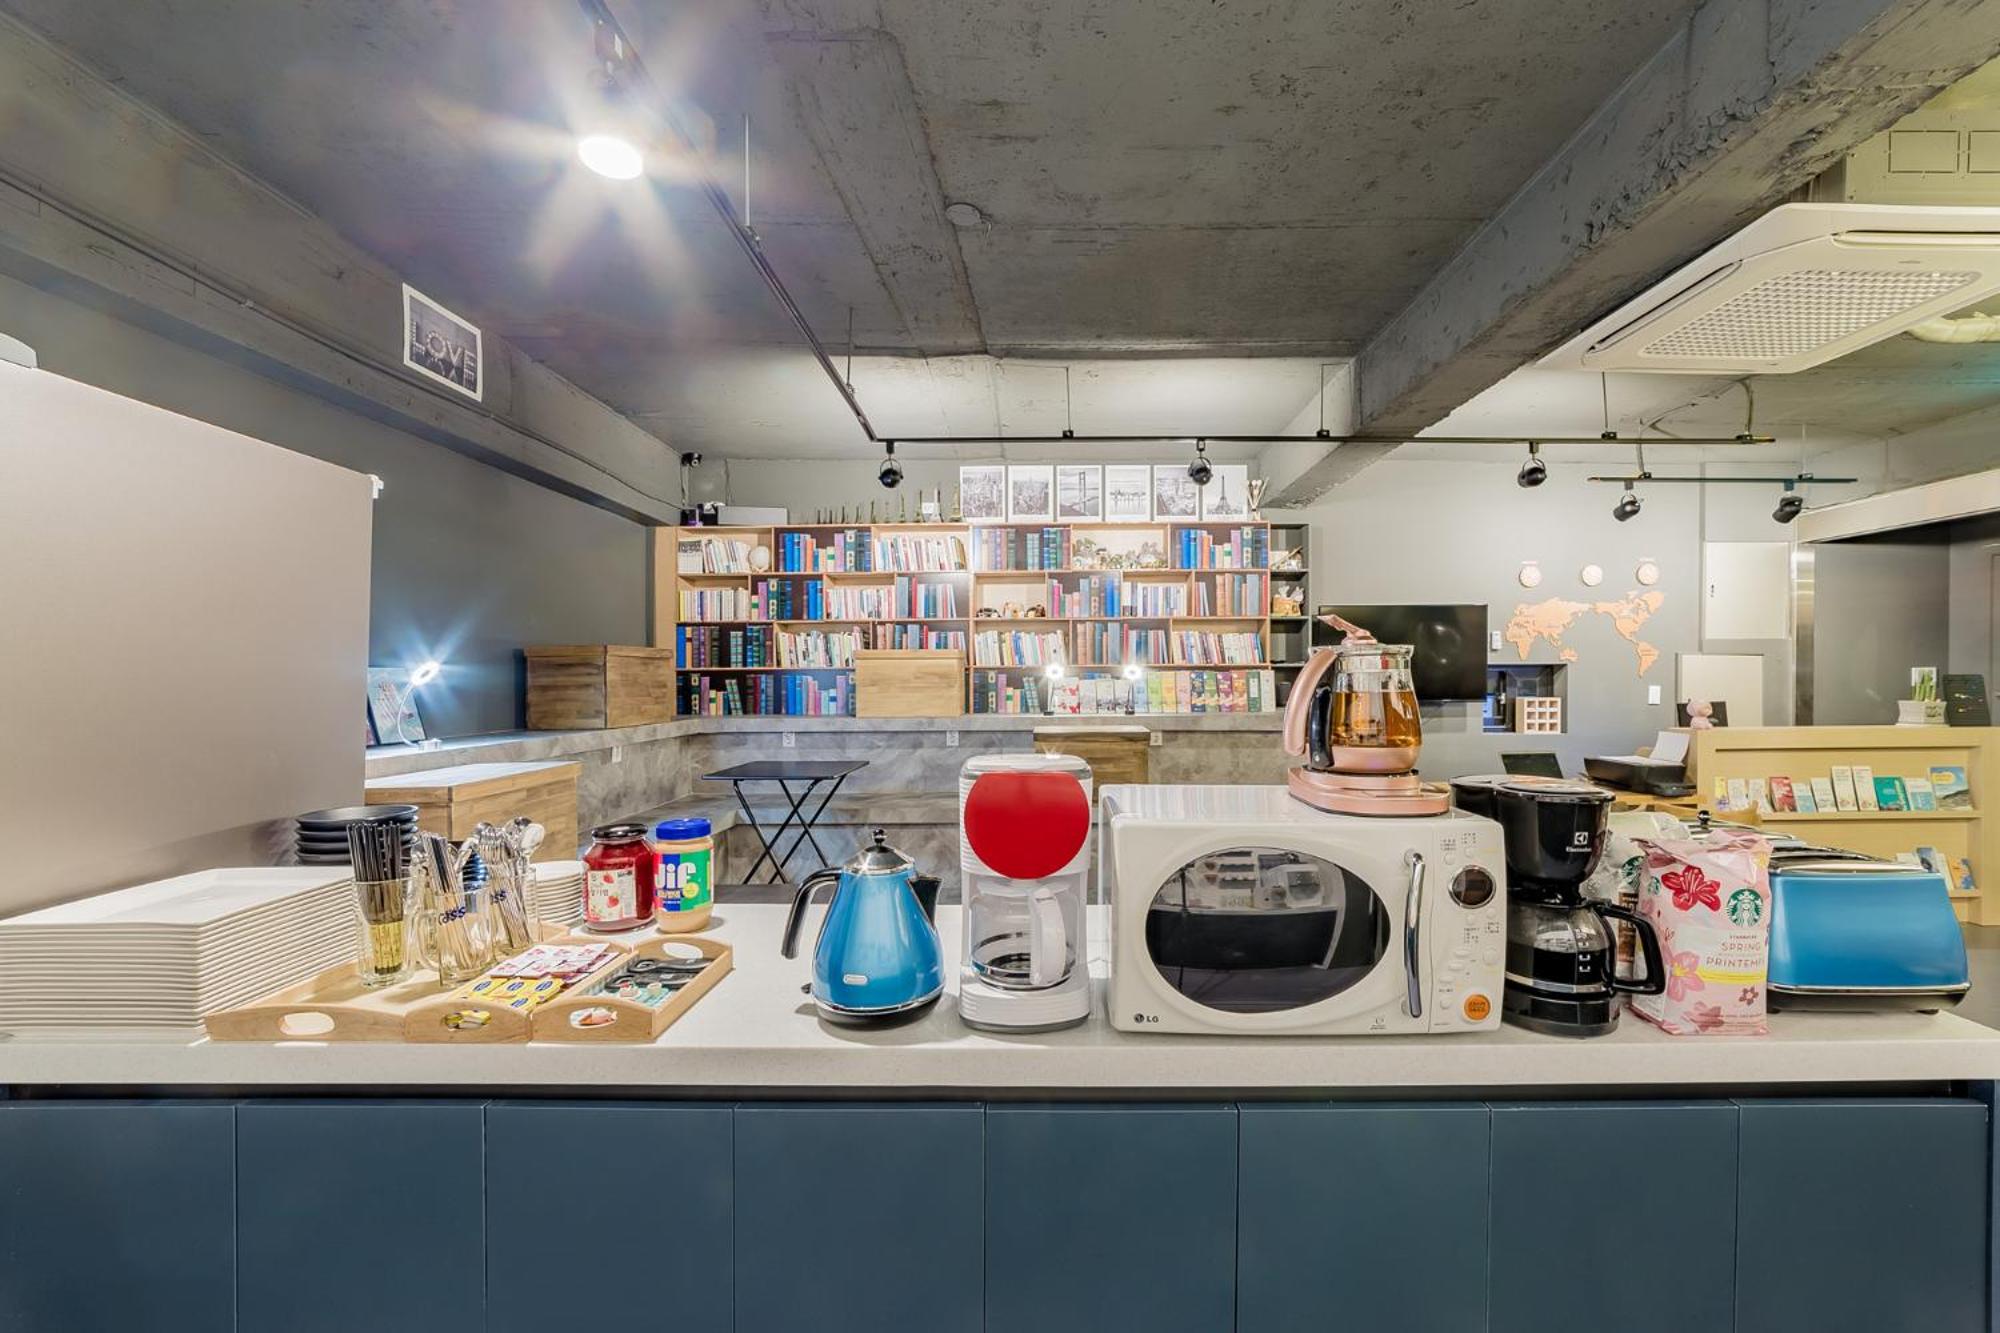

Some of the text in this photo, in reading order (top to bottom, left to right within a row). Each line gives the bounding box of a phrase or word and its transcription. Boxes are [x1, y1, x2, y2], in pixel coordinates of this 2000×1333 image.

[411, 320, 476, 380] LOVE
[655, 862, 697, 889] Jif
[1721, 942, 1761, 952] SPRING
[1706, 956, 1764, 969] PRINTEM
[1146, 1015, 1159, 1023] LG
